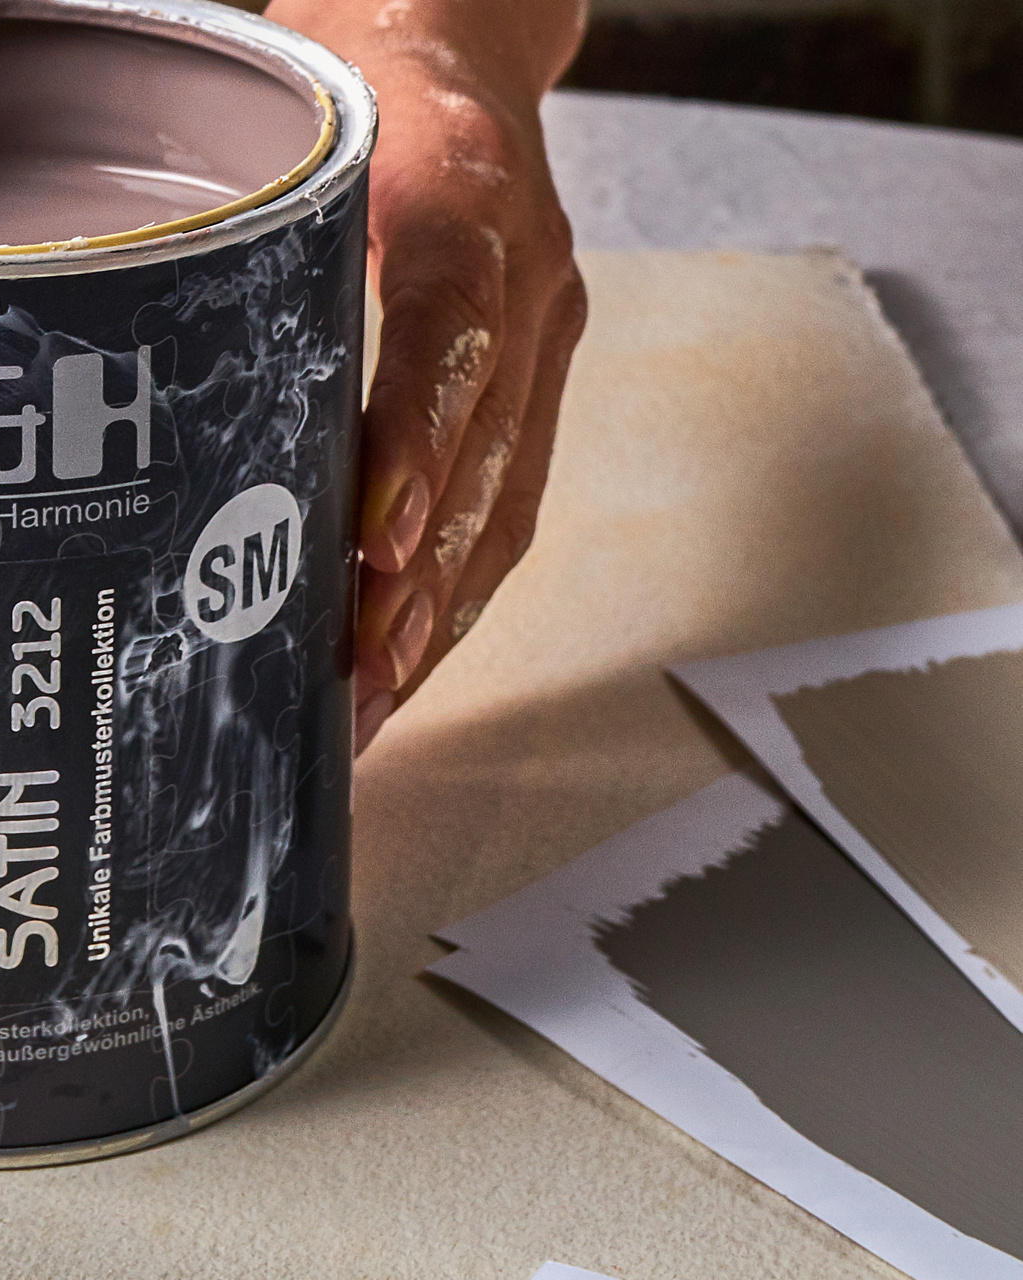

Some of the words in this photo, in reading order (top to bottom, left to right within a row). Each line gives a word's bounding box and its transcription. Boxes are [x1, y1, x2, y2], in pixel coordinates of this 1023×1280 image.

[197, 517, 290, 623] SM
[11, 597, 62, 732] 3212
[88, 588, 115, 862] Farbmusterkollektion
[87, 867, 112, 962] Unikale
